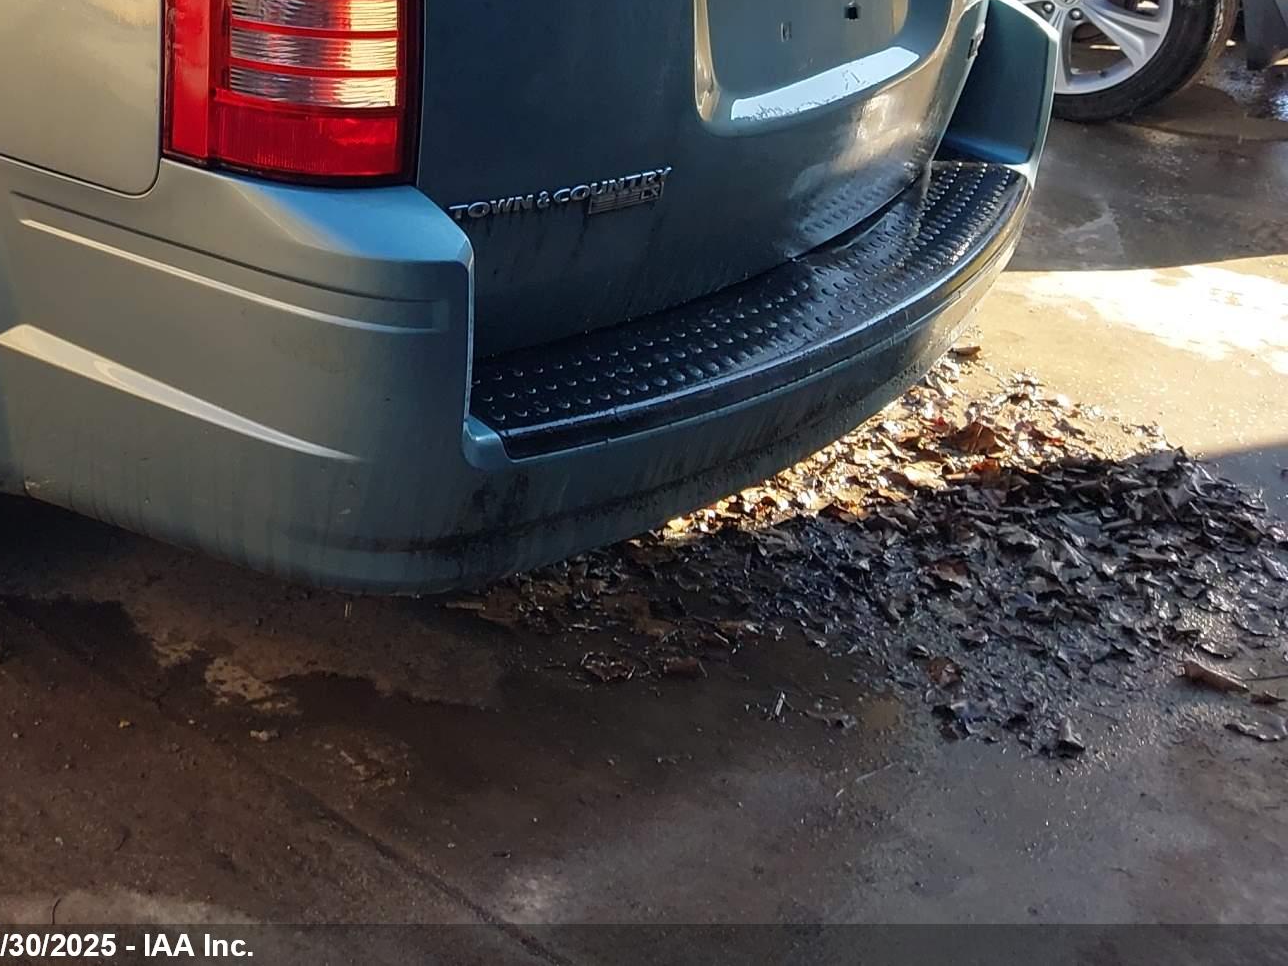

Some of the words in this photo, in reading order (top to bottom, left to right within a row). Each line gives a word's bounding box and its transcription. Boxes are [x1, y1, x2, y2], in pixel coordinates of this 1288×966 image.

[448, 194, 533, 219] TOWN
[537, 190, 550, 209] &
[553, 166, 672, 203] COUNTRY
